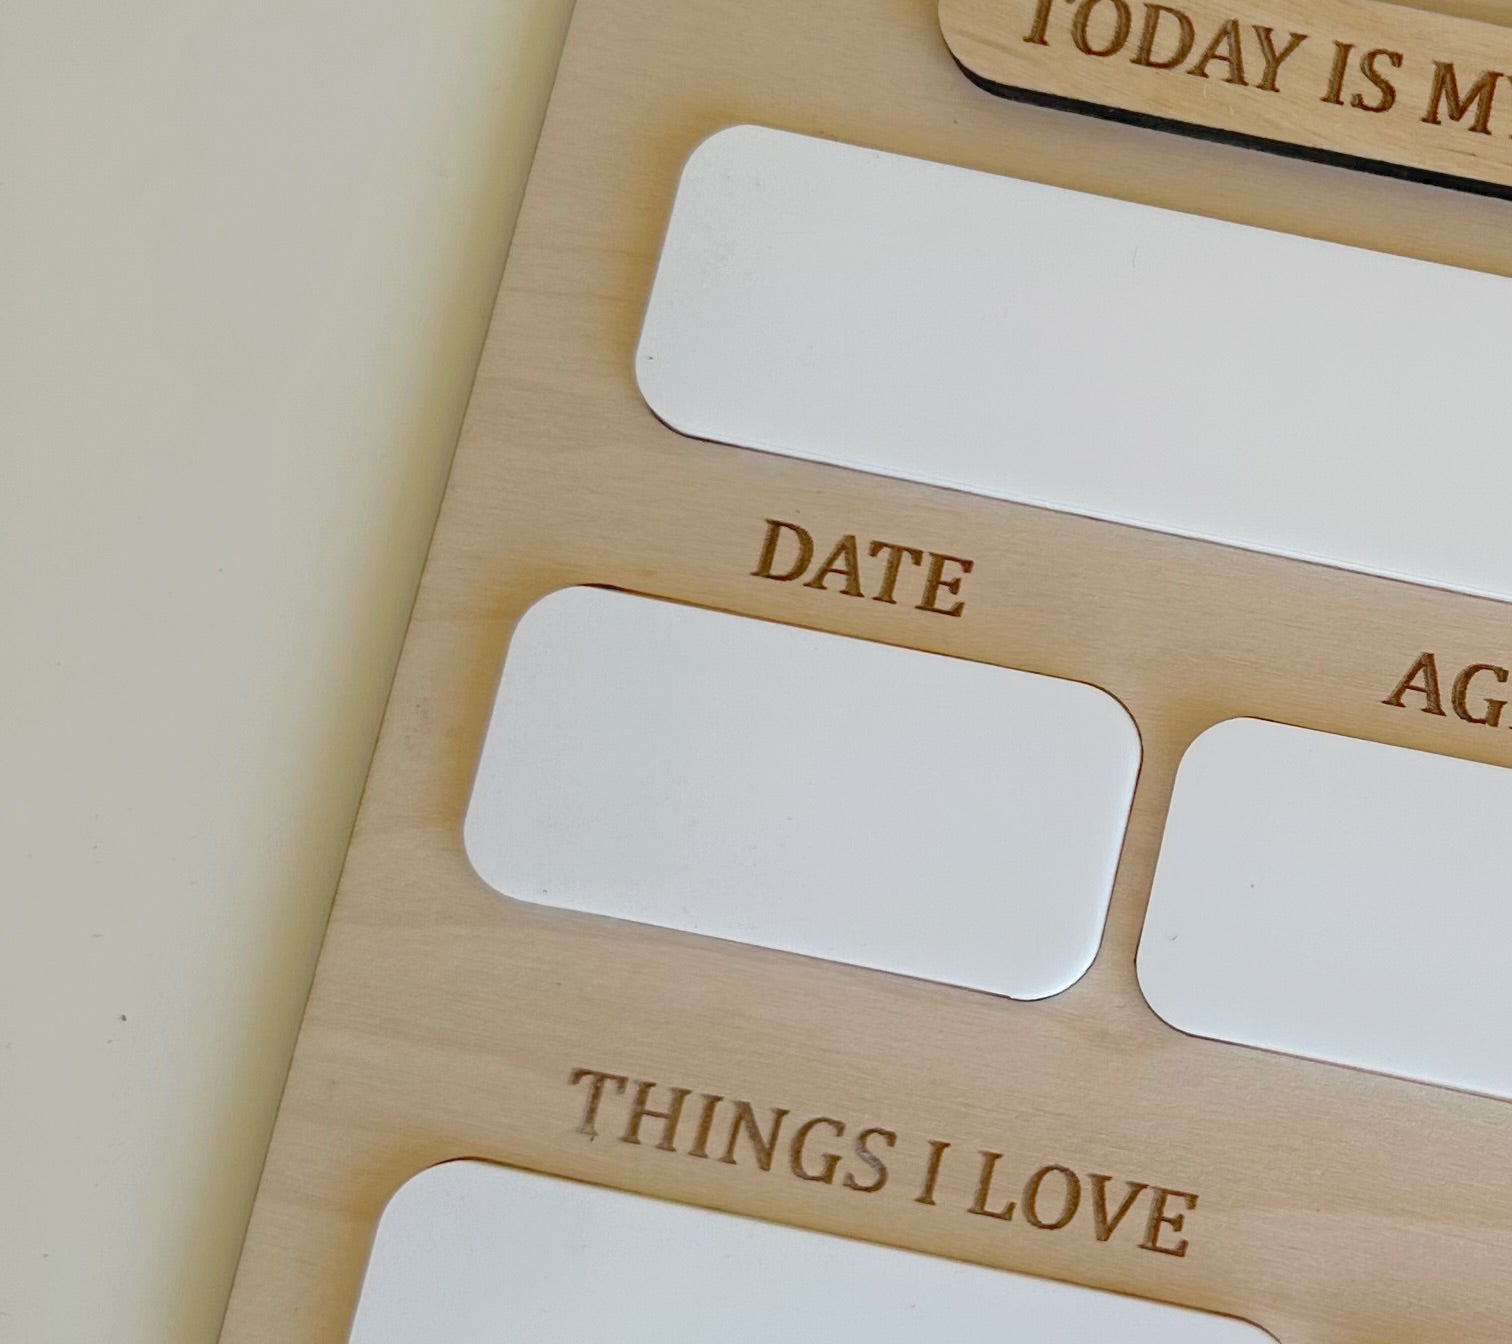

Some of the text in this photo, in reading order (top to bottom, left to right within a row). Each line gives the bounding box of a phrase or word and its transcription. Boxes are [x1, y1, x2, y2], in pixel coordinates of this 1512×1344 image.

[1320, 40, 1403, 113] IS
[749, 518, 975, 620] DATE
[568, 1068, 1199, 1260] THINGS I LOVE
